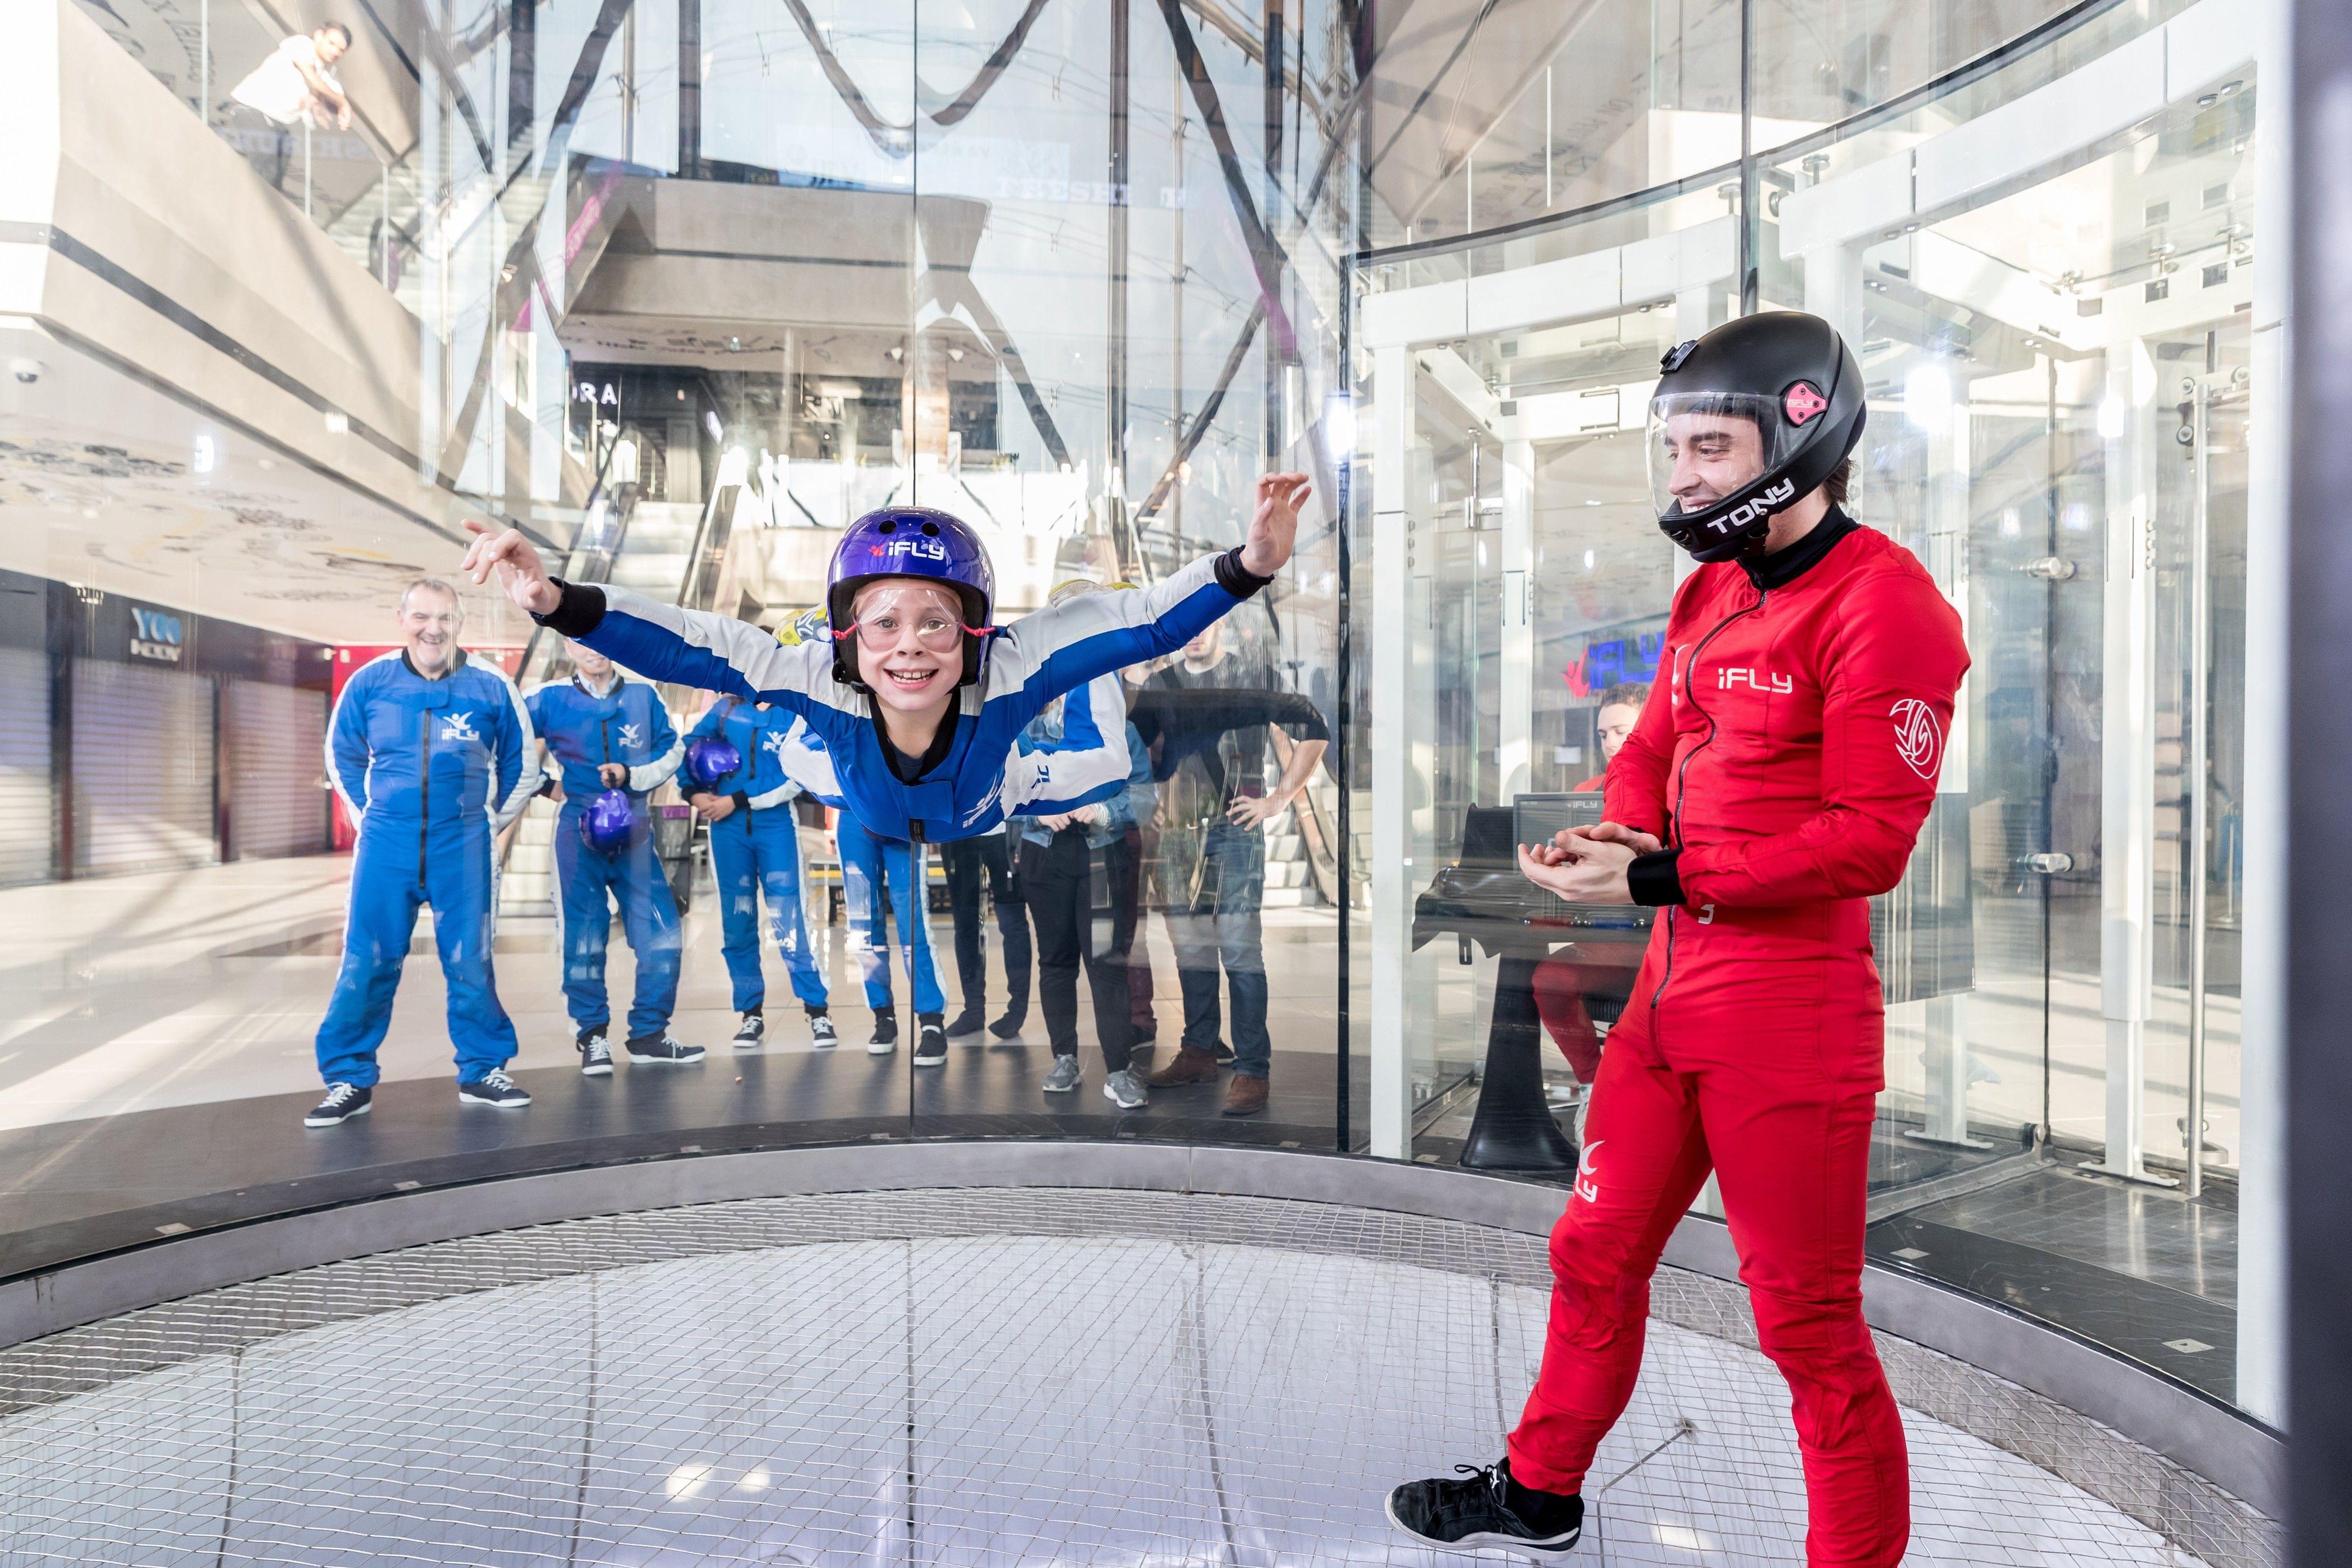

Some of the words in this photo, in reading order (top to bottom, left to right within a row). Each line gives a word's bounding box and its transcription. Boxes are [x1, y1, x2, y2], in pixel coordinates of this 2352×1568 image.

[1707, 477, 1795, 534] TONY
[888, 541, 944, 561] iFLY
[1718, 668, 1793, 694] iFLY
[1573, 800, 1598, 808] iFLY
